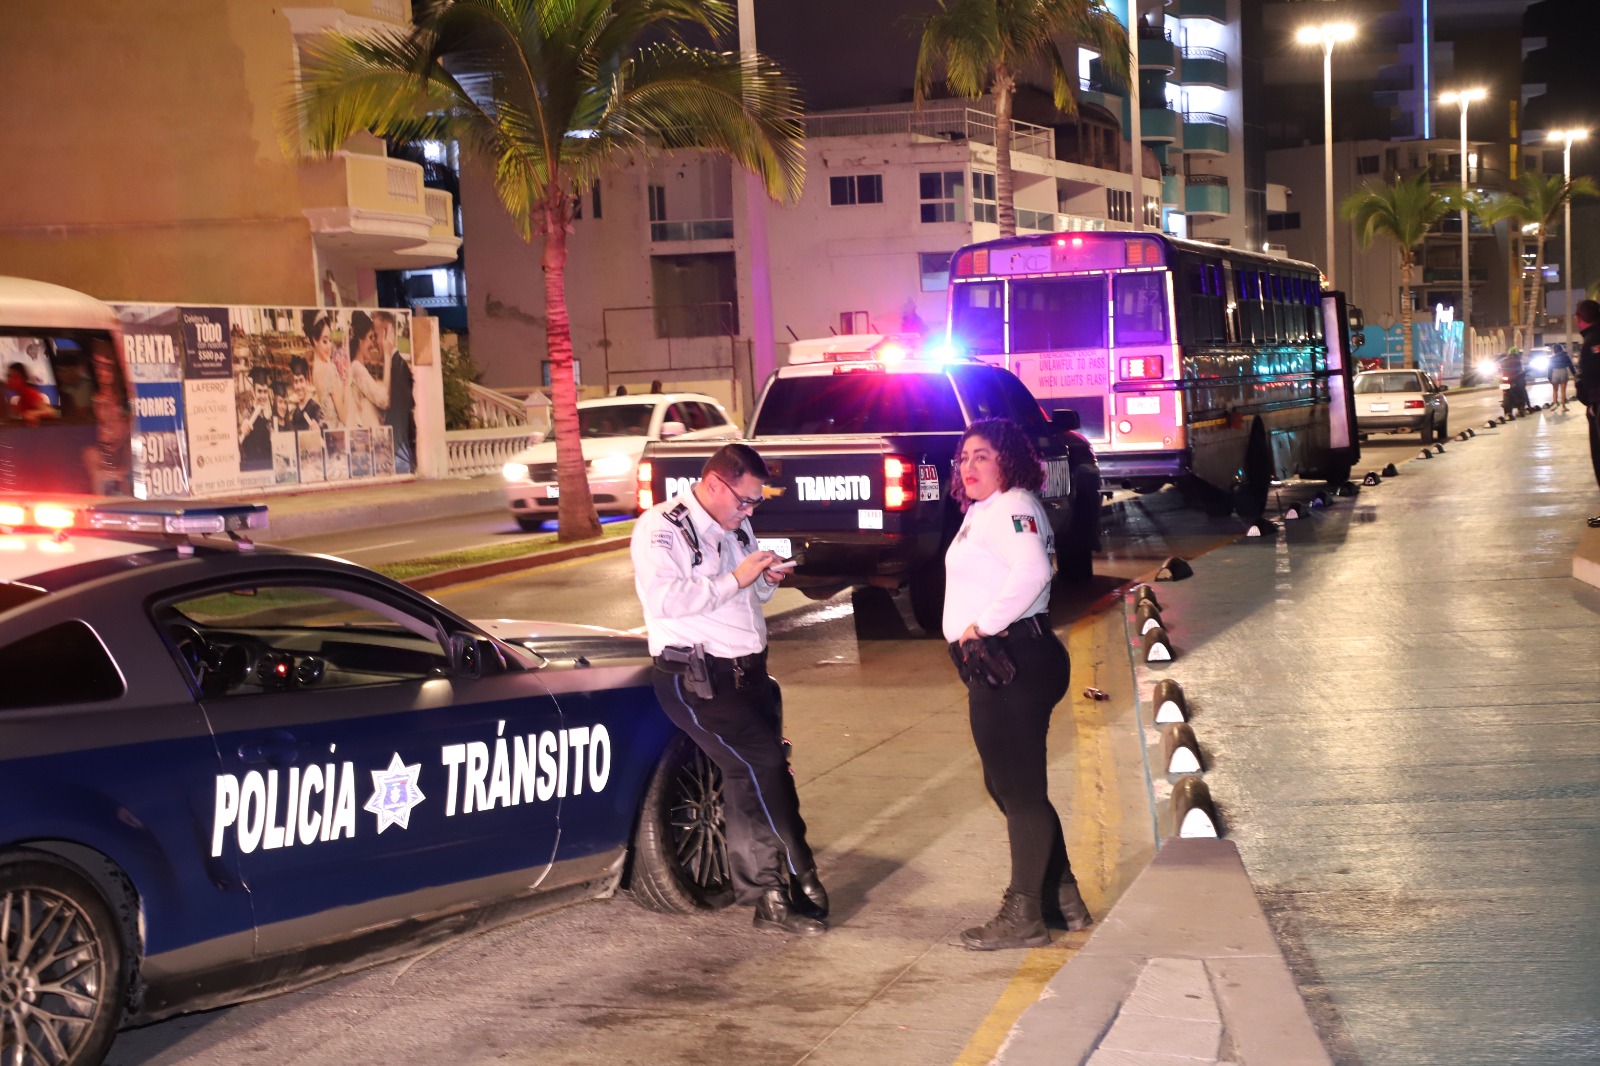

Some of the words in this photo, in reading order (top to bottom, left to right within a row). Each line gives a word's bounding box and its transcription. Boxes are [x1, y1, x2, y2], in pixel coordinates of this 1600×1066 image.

[195, 321, 223, 344] TODO
[123, 333, 176, 364] RENTA
[1039, 359, 1074, 372] UNLAWFUL
[1077, 358, 1086, 369] TO
[1089, 357, 1106, 369] PASS
[1039, 375, 1058, 387] WHEN
[1060, 374, 1084, 387] LIGHTS
[1086, 373, 1107, 386] FLASH
[131, 395, 177, 417] FORMES
[920, 466, 938, 480] 911
[1041, 459, 1071, 498] RANSITO
[795, 475, 871, 501] TRANSITO
[212, 743, 356, 858] POLICÍA
[441, 719, 612, 817] TRÁNSITO
